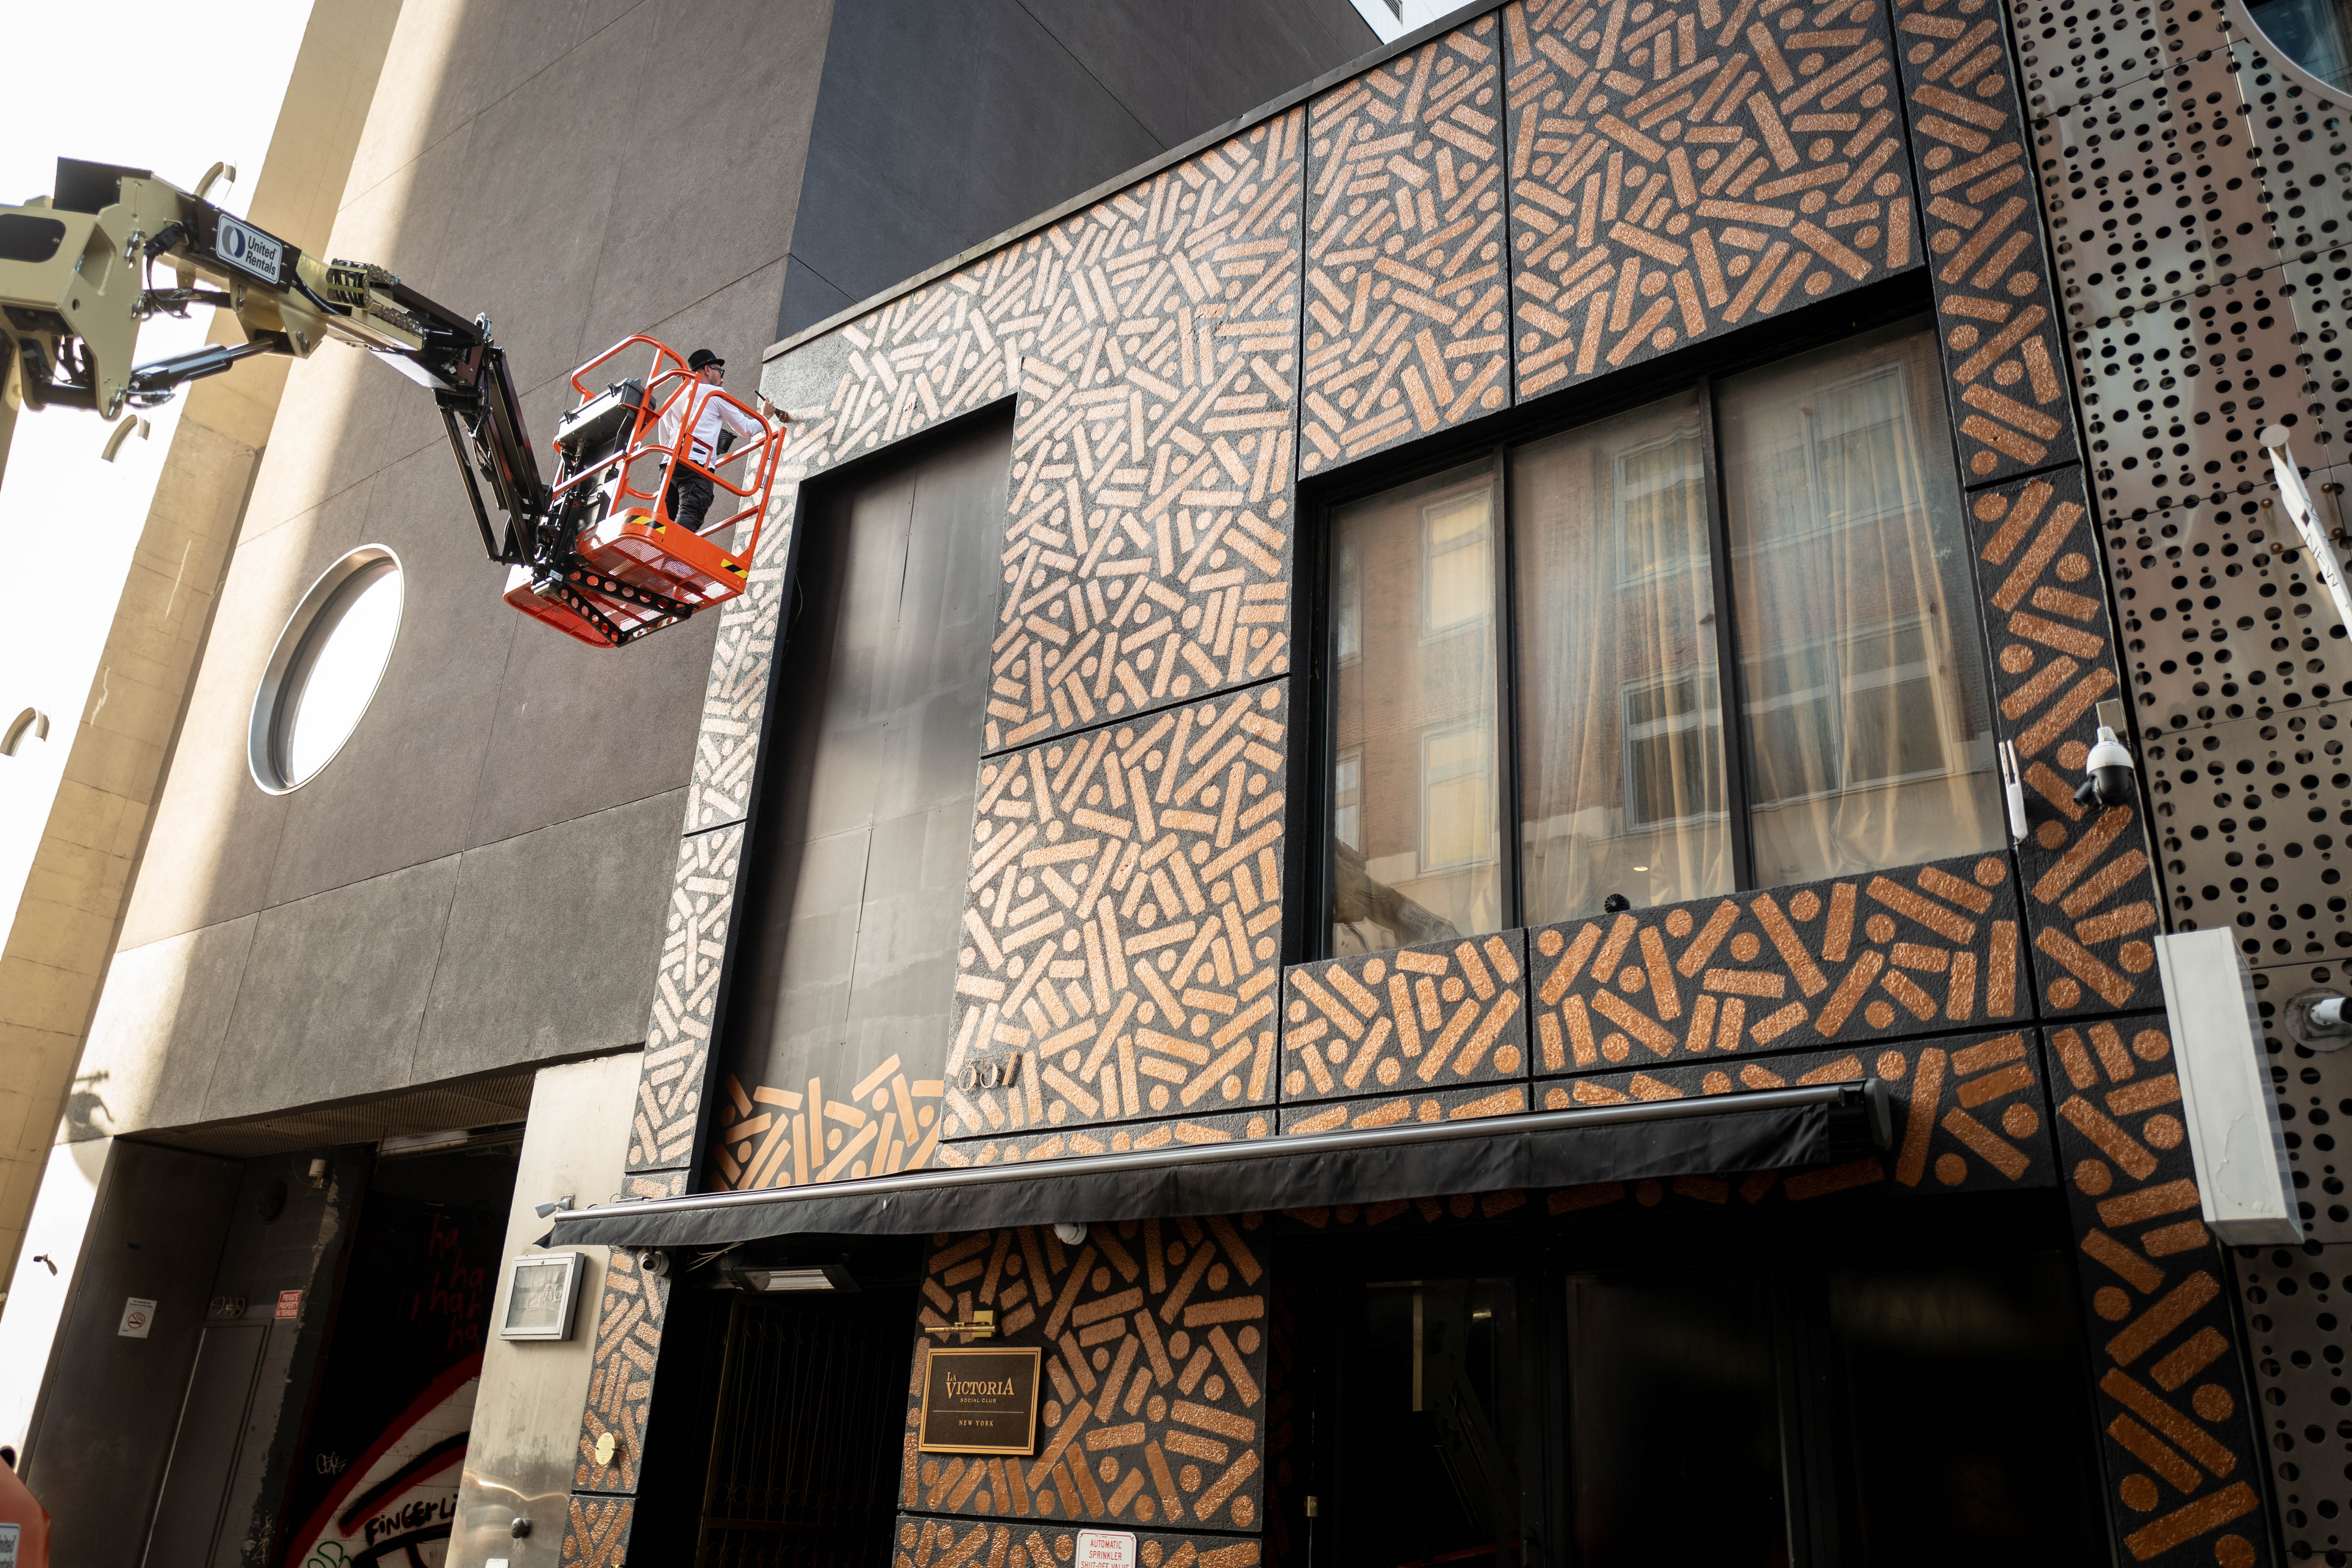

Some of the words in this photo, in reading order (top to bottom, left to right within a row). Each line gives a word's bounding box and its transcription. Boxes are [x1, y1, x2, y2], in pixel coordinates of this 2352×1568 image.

[248, 236, 276, 260] United
[246, 250, 276, 276] Rentals
[946, 1377, 1014, 1399] VICTORIA
[1090, 1539, 1122, 1549] AUTOMATIC
[1089, 1551, 1122, 1560] SPRINKLER
